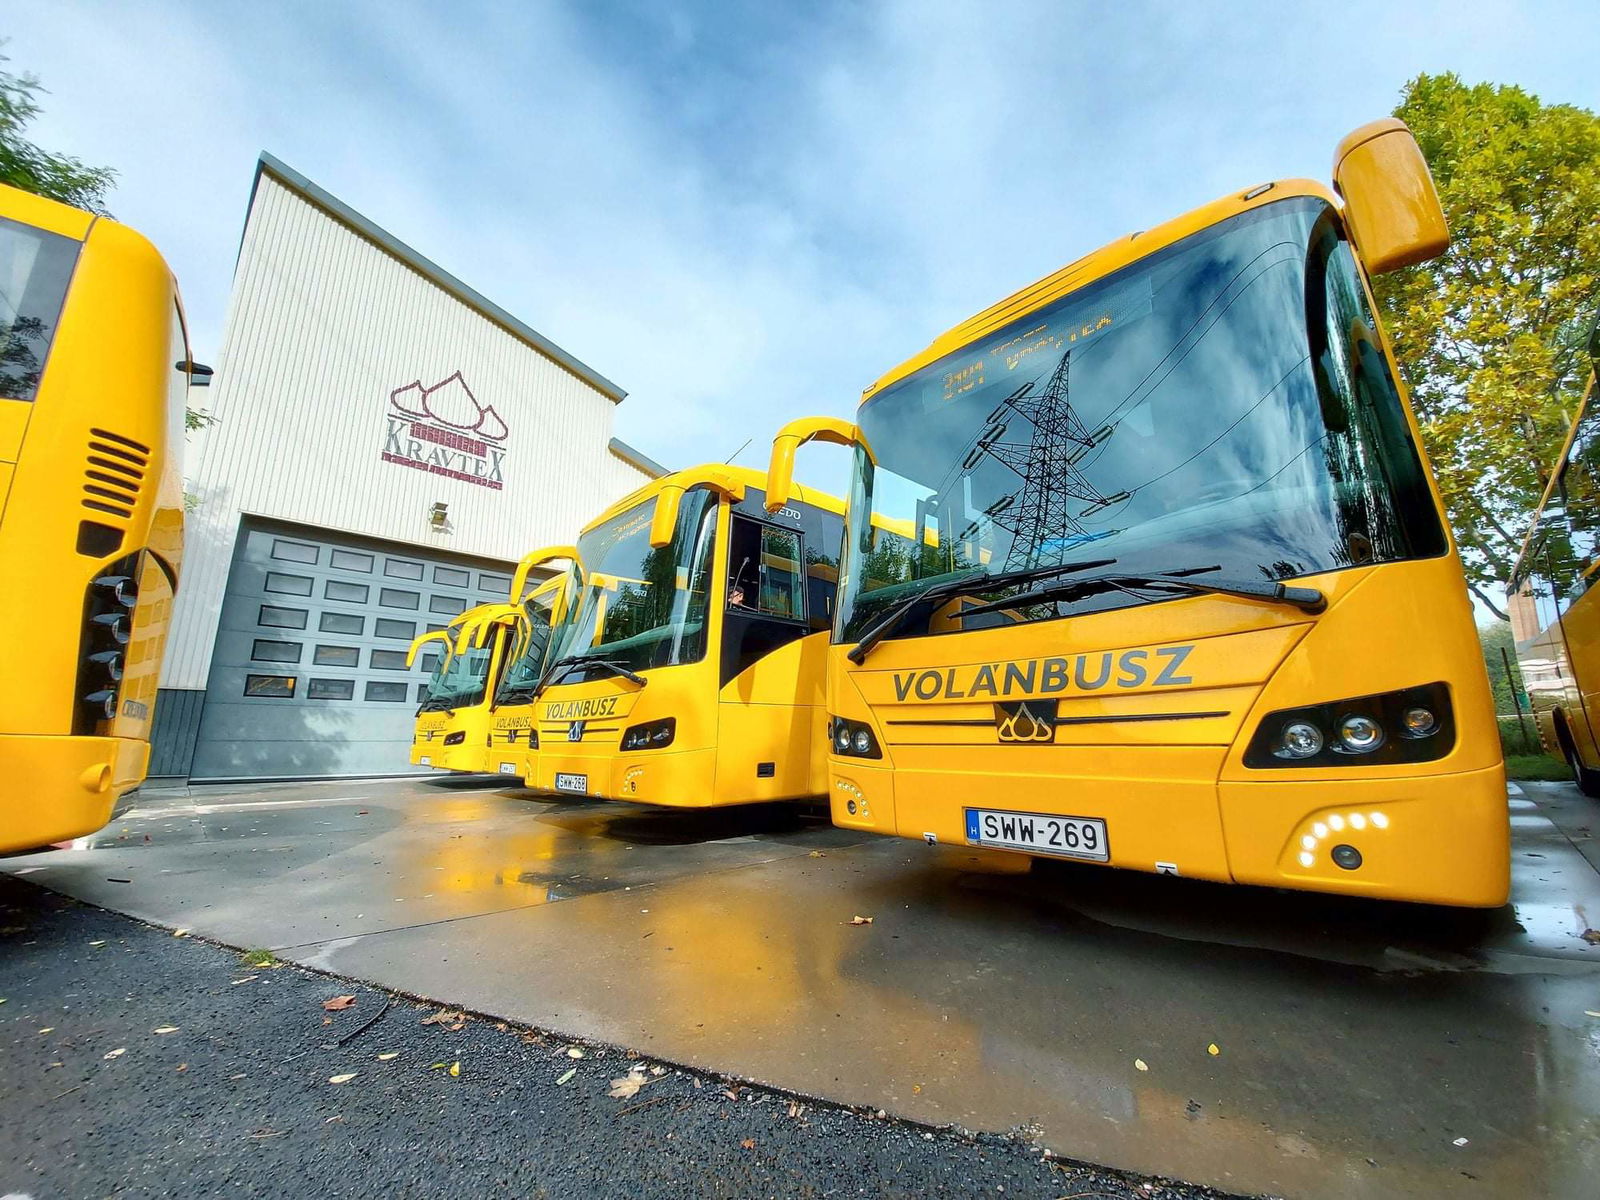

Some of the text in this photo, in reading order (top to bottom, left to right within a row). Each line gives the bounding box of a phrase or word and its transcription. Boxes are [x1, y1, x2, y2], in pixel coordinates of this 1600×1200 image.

[383, 418, 506, 482] KRAVTEX
[893, 645, 1196, 702] VOLÁNBUSZ
[984, 815, 1098, 850] SWW-269
